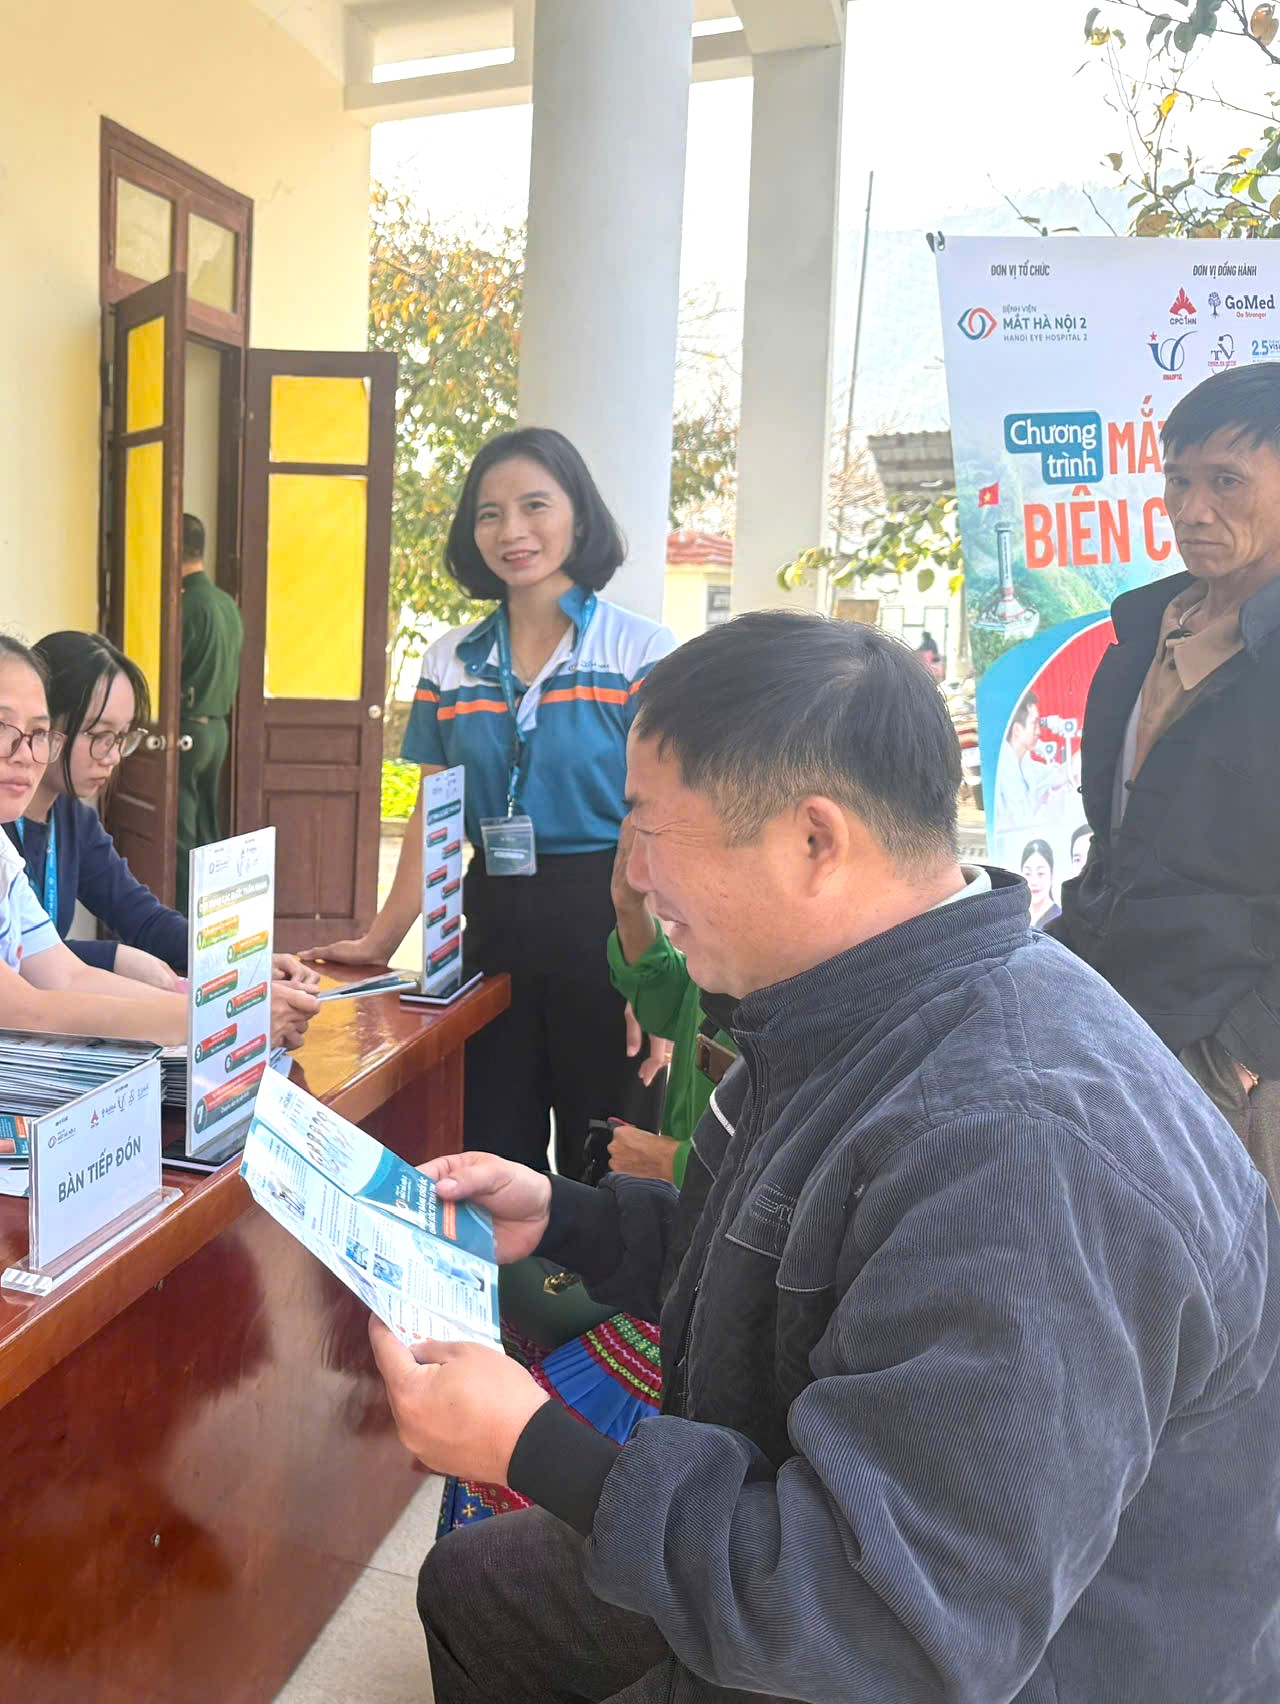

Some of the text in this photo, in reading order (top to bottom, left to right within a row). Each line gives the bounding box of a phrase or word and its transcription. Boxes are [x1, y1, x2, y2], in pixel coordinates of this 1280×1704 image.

[991, 259, 1050, 279] ĐƠN VỊ TỔ CHỨC
[1193, 264, 1207, 276] ĐƠN
[1210, 265, 1216, 279] VỊ
[1238, 263, 1256, 276] HÀNH
[1225, 294, 1275, 309] GoMed
[1003, 313, 1087, 332] MẮT HÀ NỘI 2
[1004, 334, 1027, 342] HANOI
[1252, 340, 1268, 355] 2.5
[1010, 419, 1097, 450] Chương
[1108, 395, 1166, 475] MẮ
[1047, 451, 1097, 478] trình
[1023, 485, 1131, 569] BIÊN
[58, 1136, 141, 1203] BÀN TIẾP ĐÓN
